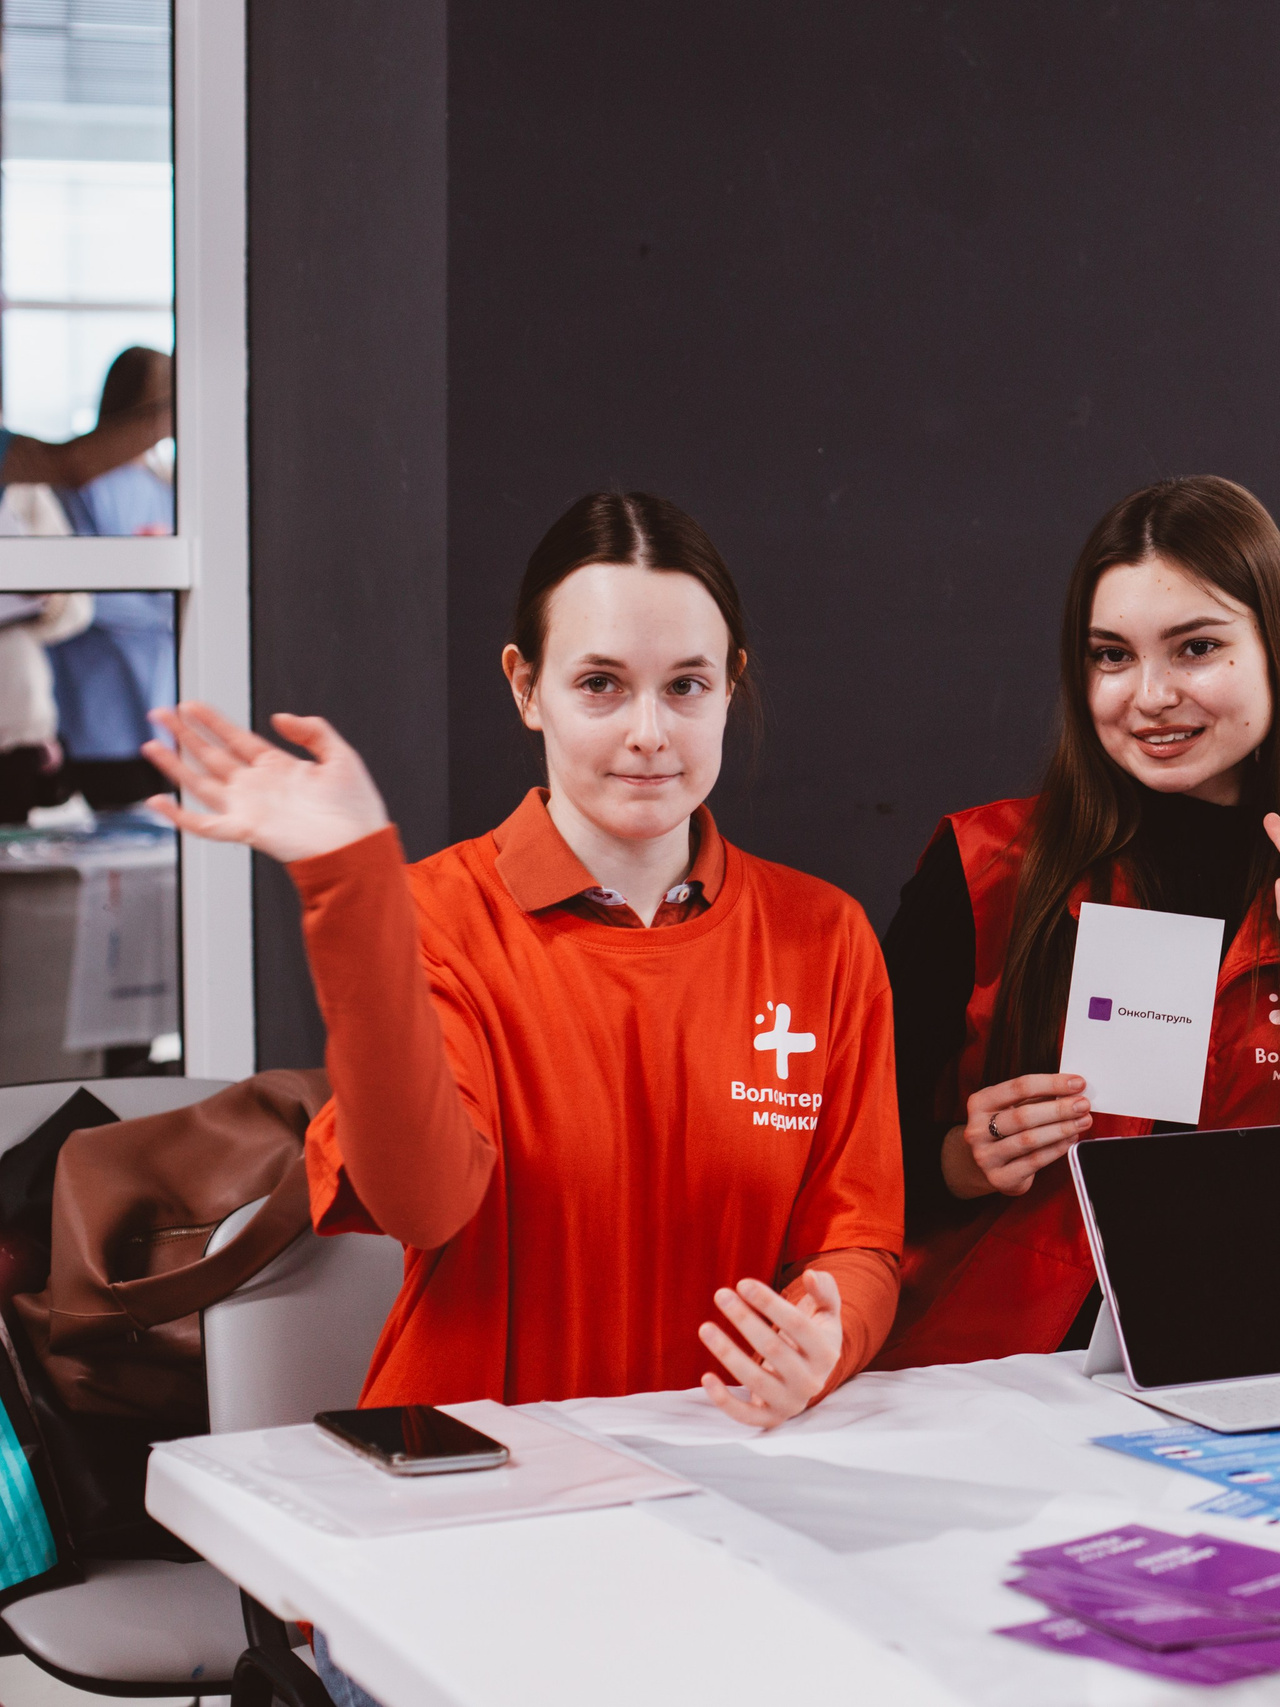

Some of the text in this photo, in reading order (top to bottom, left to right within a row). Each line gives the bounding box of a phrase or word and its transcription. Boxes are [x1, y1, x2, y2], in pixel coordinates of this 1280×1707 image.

[1117, 1007, 1192, 1025] ОнкоПатруль
[730, 1080, 823, 1112] Волонтер
[752, 1111, 818, 1132] медики
